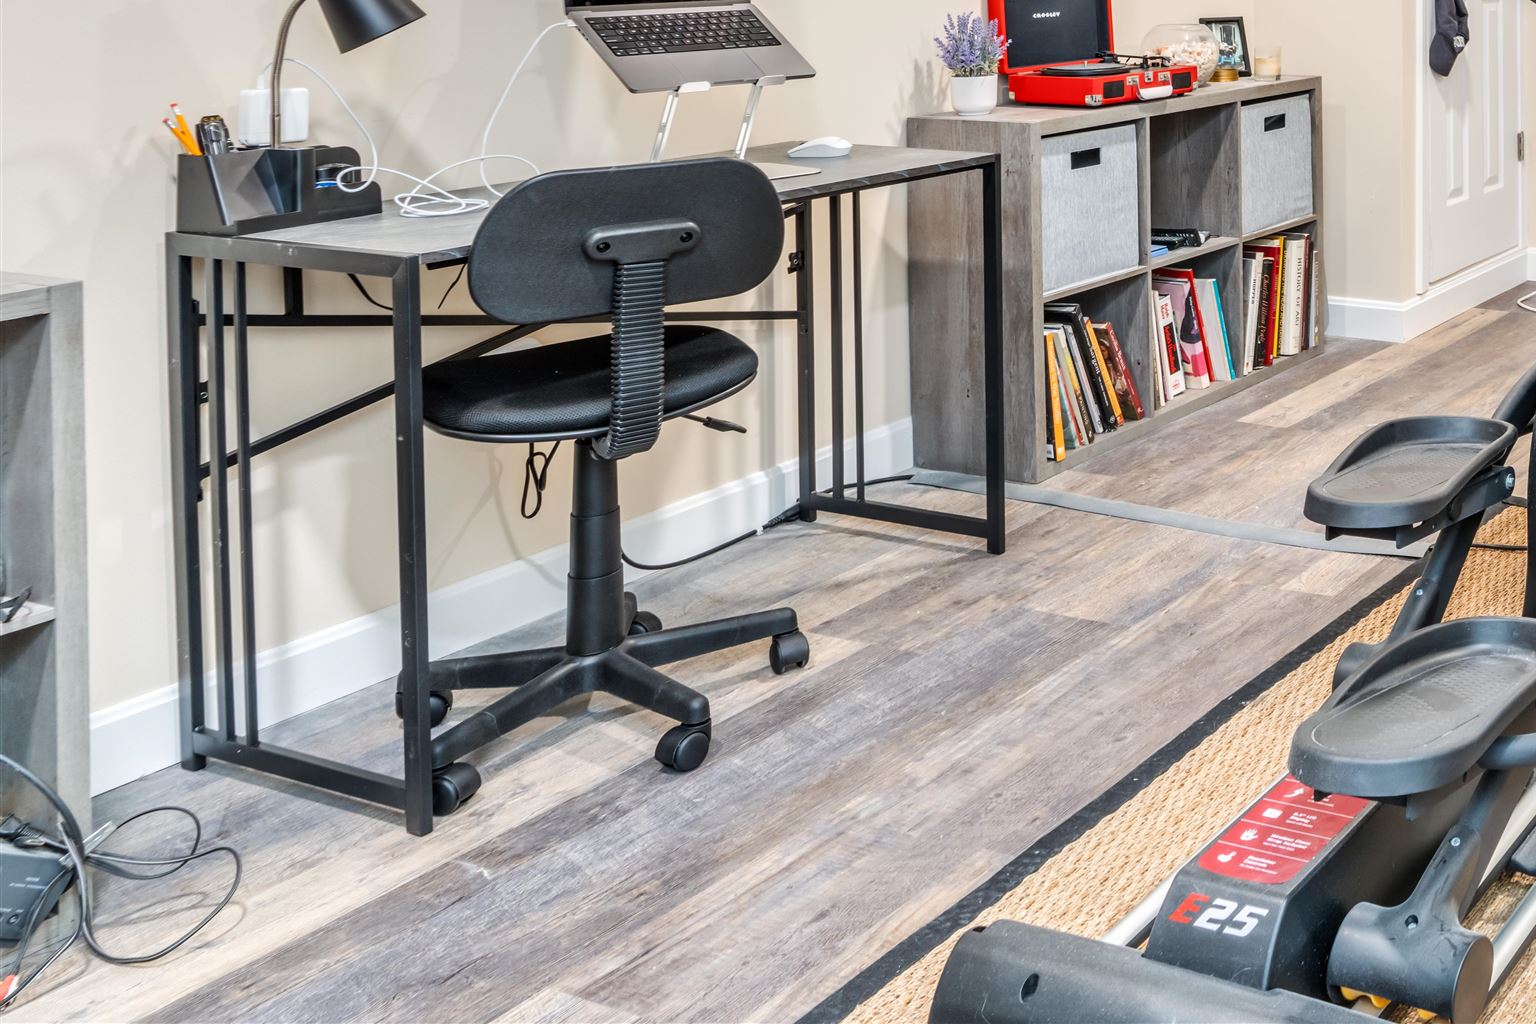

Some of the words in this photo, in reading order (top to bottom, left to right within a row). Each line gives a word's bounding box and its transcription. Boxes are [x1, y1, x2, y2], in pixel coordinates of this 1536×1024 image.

[1262, 274, 1270, 301] Charles
[1296, 298, 1301, 309] OF
[1089, 347, 1101, 374] Sargent
[1078, 392, 1089, 424] PAINTING
[1168, 892, 1269, 937] E25
